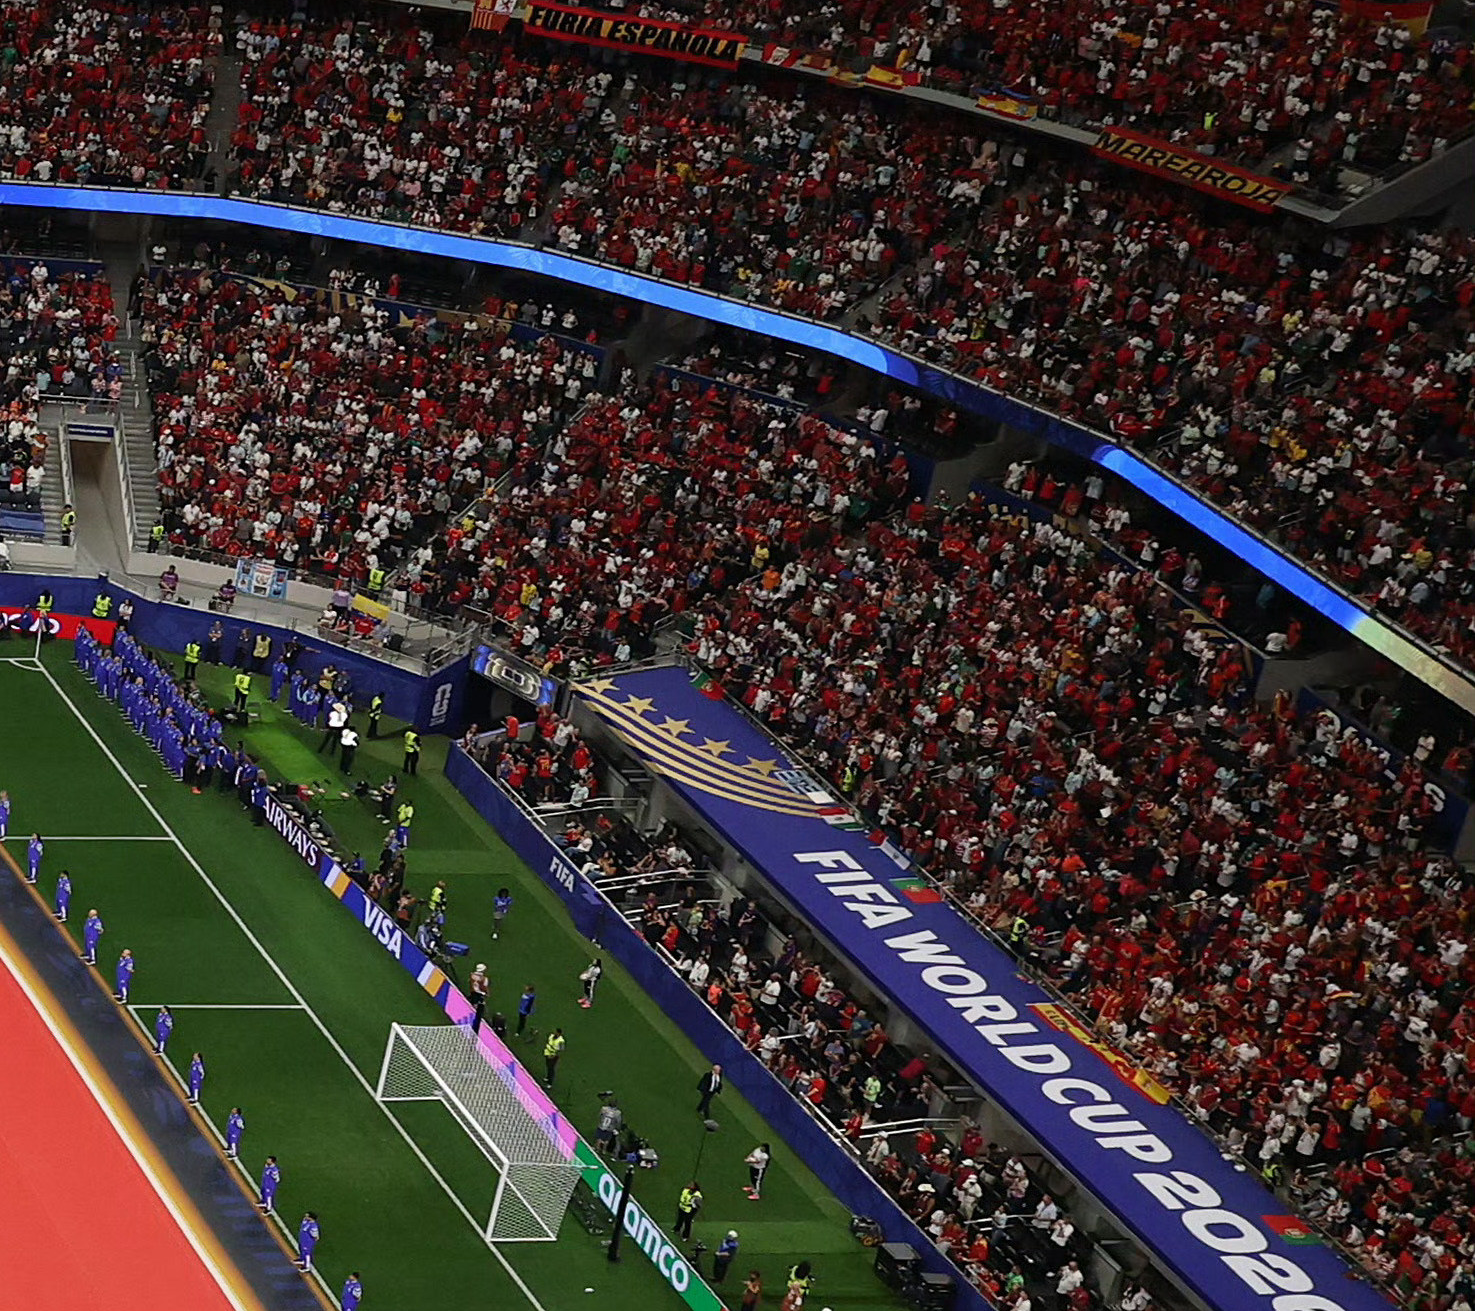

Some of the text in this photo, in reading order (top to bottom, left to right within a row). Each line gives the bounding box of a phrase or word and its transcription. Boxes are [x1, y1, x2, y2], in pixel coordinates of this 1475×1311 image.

[527, 5, 604, 46] FURIA
[549, 856, 576, 893] FIFA
[362, 894, 403, 960] VISA
[792, 849, 914, 930] FIFA
[890, 930, 1052, 1080] WORLD
[1041, 1074, 1172, 1162] CUP
